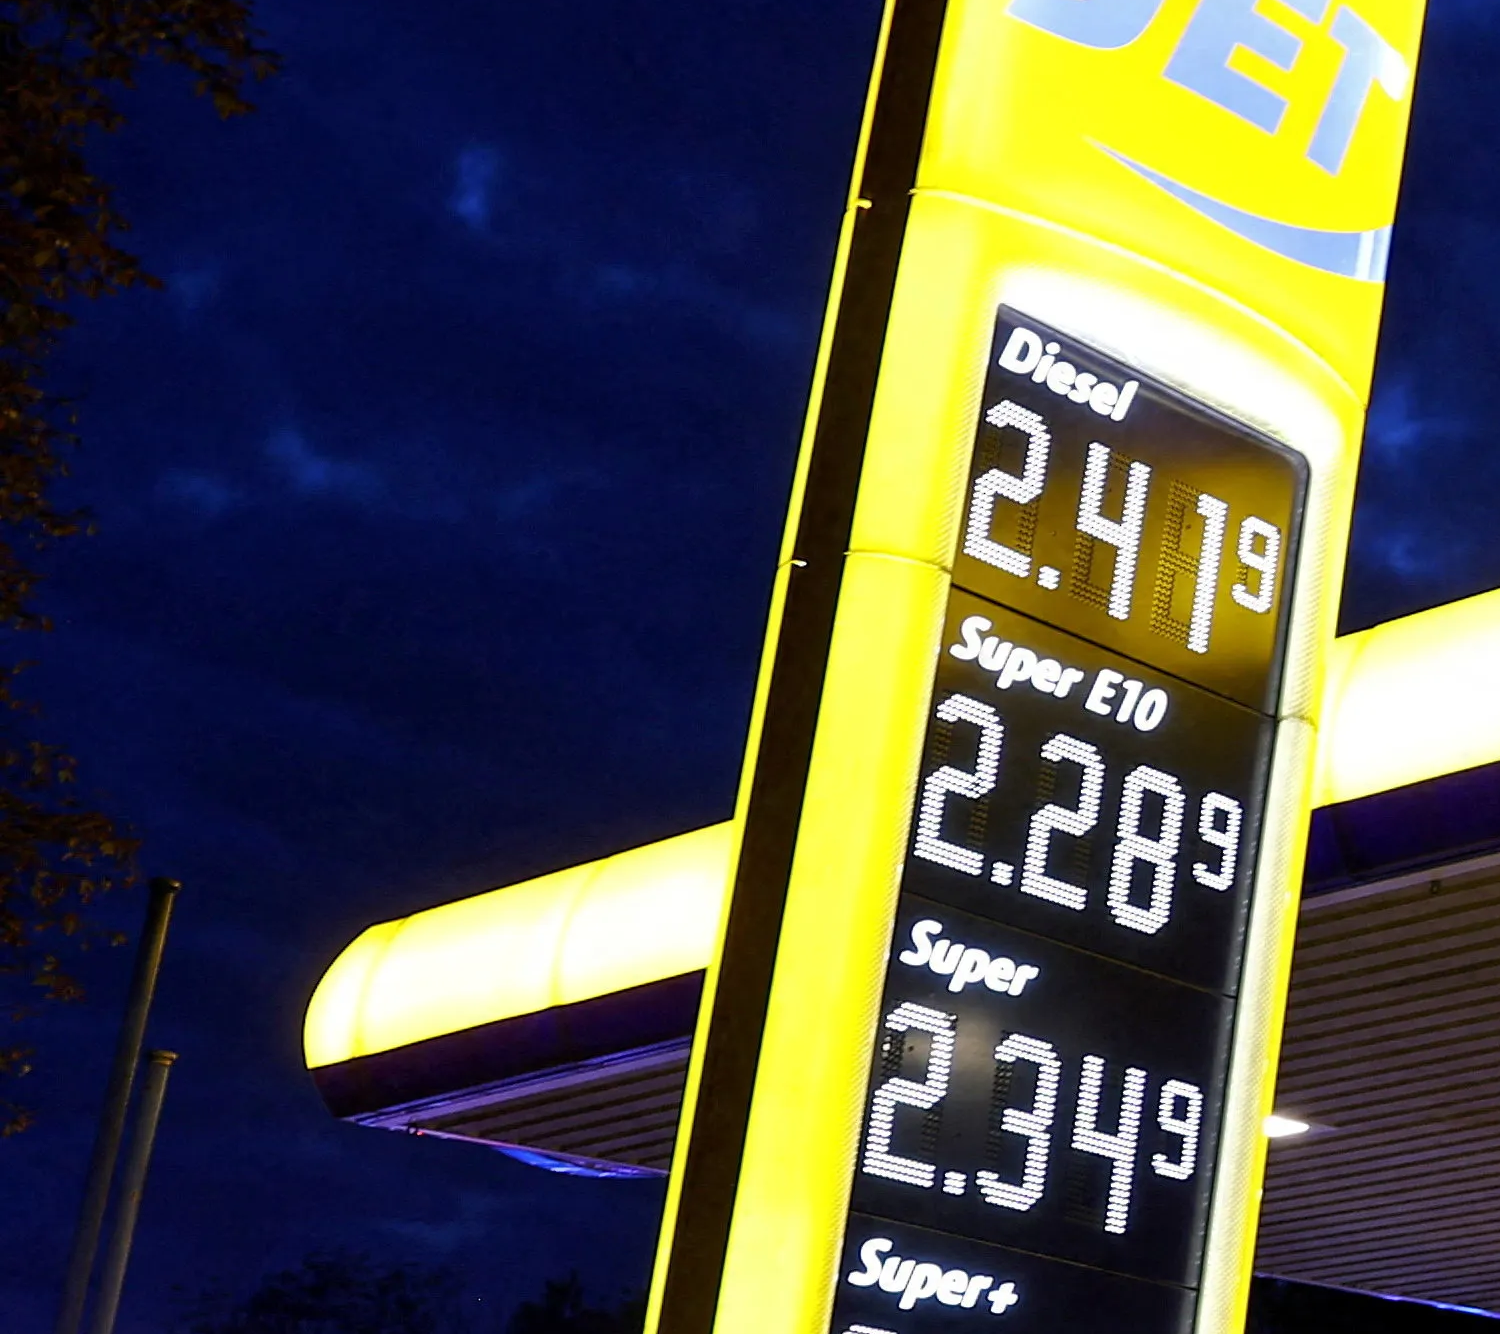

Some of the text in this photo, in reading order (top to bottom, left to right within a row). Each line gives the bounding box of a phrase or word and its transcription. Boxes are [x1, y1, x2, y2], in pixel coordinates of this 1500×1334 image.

[998, 327, 1142, 422] Diesel
[950, 615, 1169, 732] Super E10
[900, 919, 1040, 996] Super
[847, 1237, 1019, 1314] Super+
